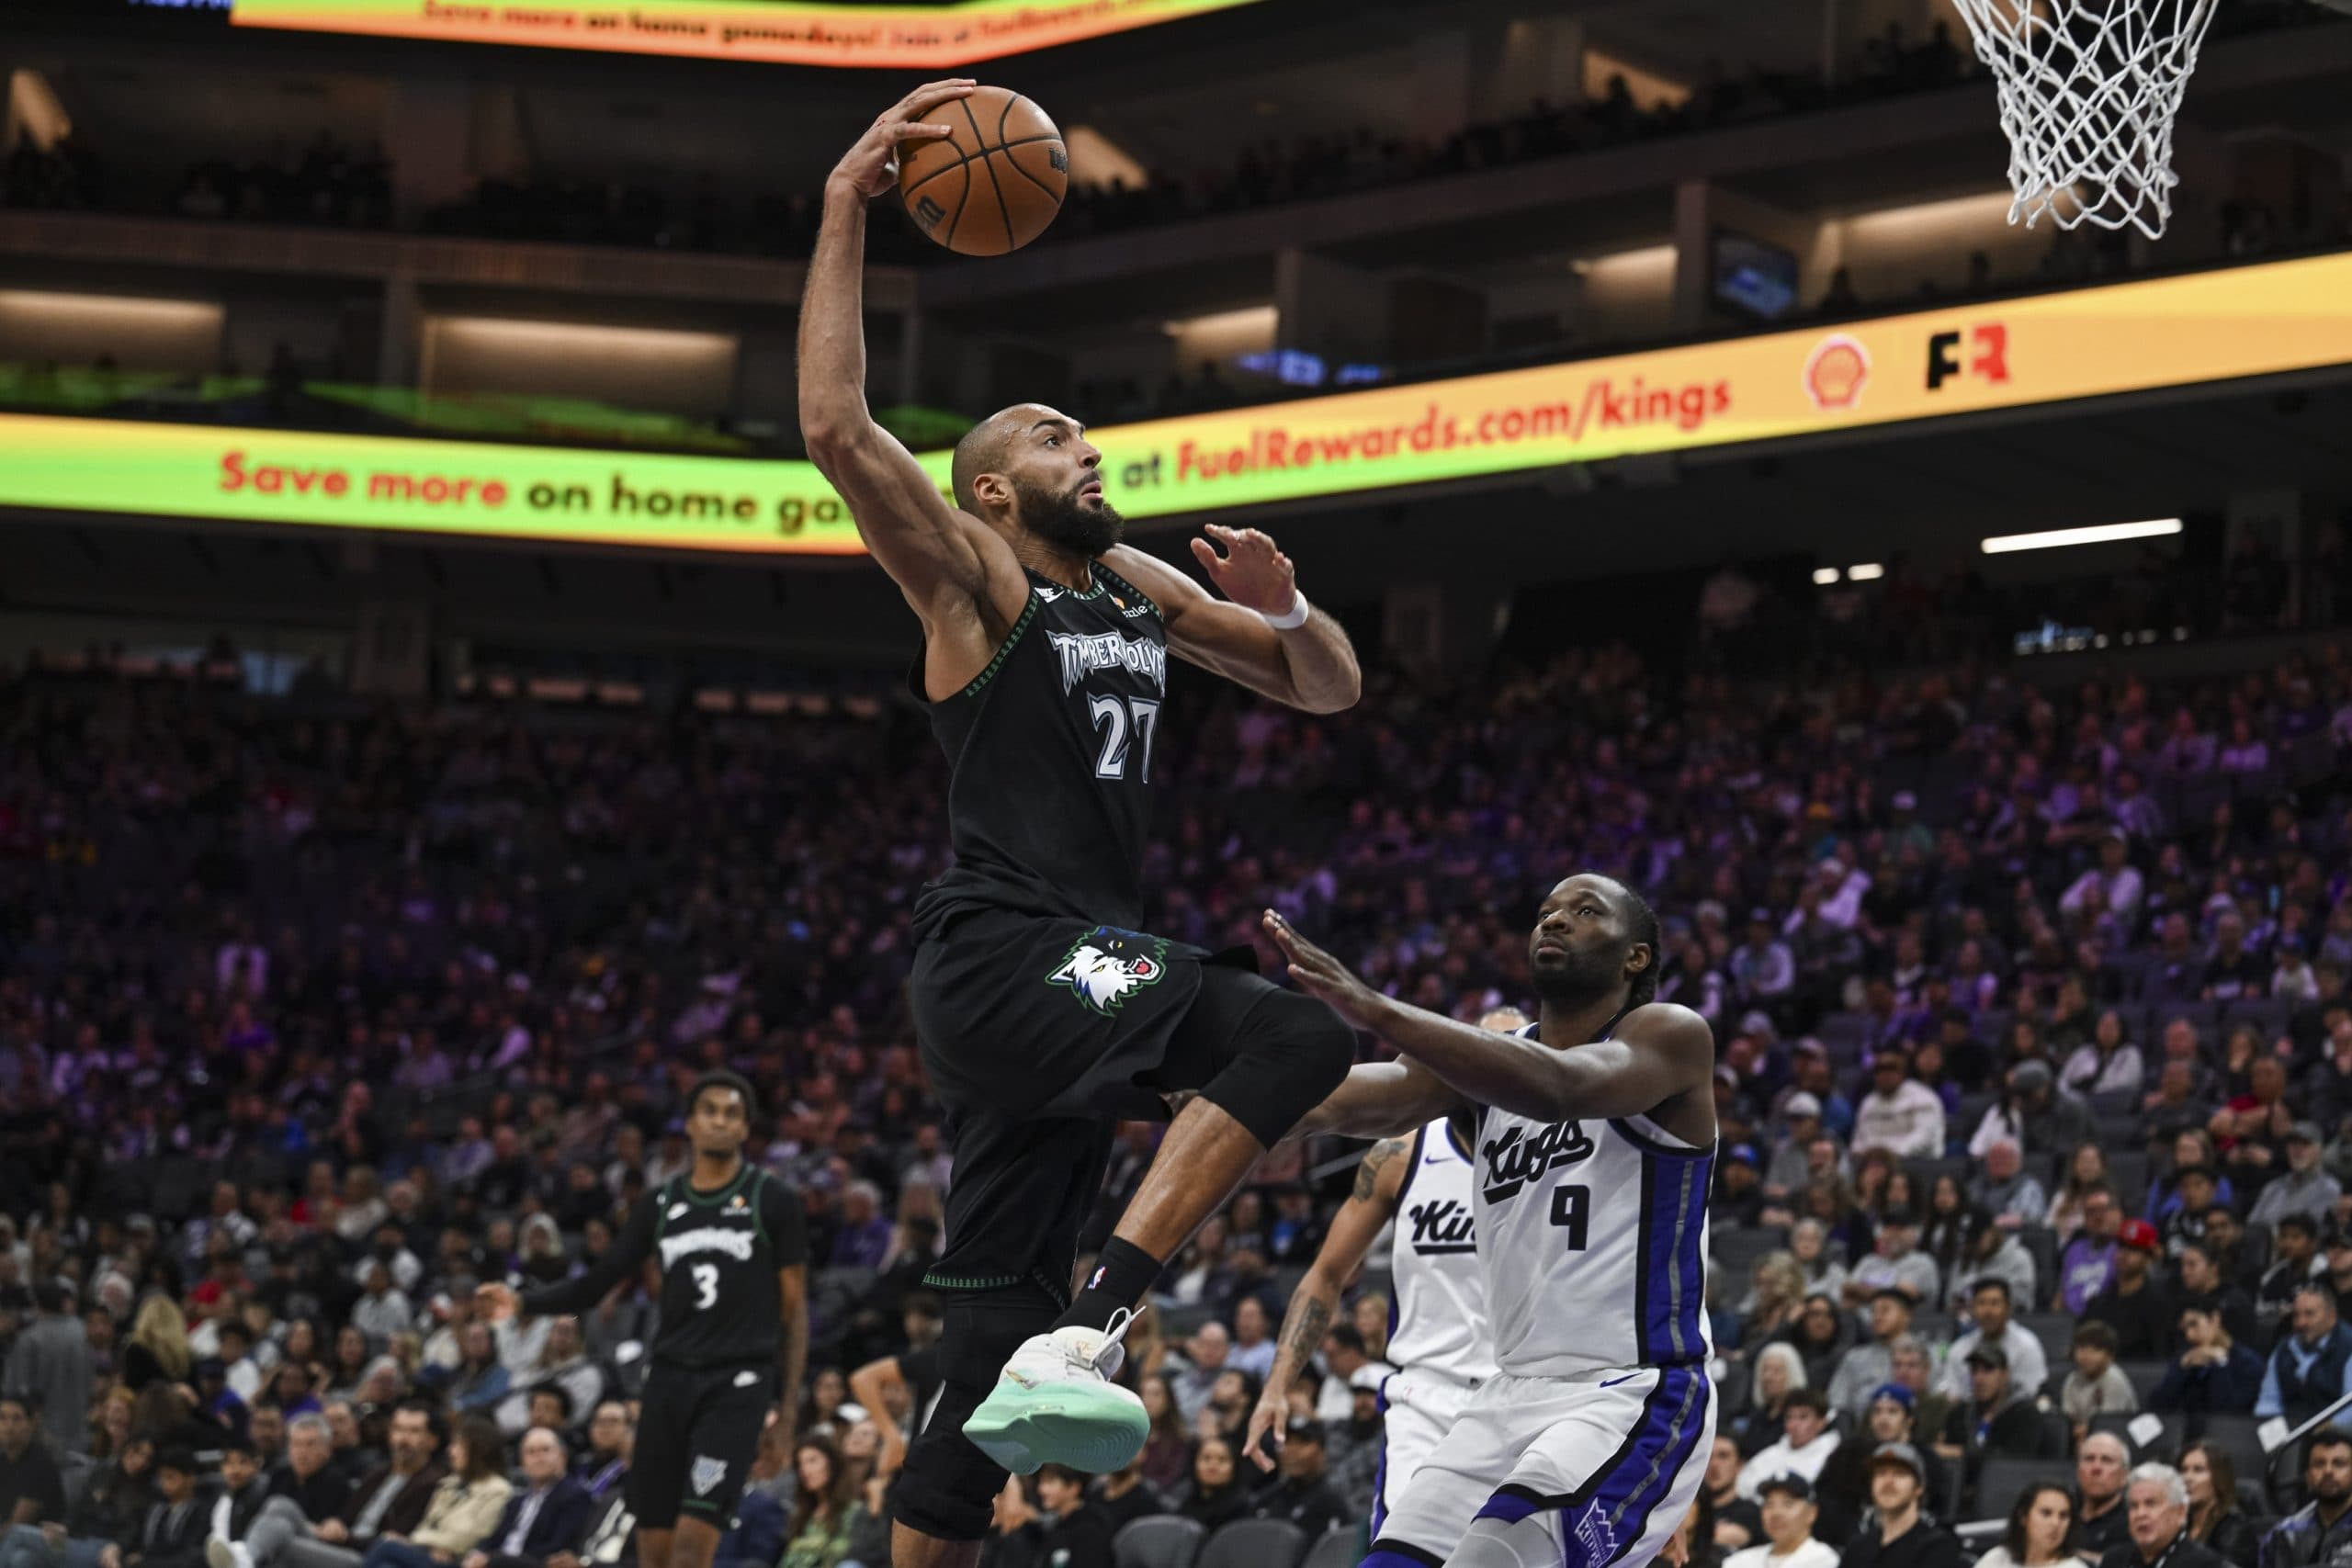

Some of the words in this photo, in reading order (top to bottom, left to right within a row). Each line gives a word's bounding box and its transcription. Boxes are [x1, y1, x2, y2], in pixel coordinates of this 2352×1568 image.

[220, 450, 349, 495] Save
[368, 470, 508, 508] more
[526, 482, 592, 510] on
[610, 472, 758, 520] home
[777, 496, 853, 536] ga
[1122, 451, 1161, 489] at
[1177, 376, 1732, 481] FuelRewards.com/kings
[1087, 691, 1160, 784] 27
[1409, 1200, 1476, 1246] Kin
[1550, 1184, 1590, 1250] 9
[692, 1264, 718, 1309] 3
